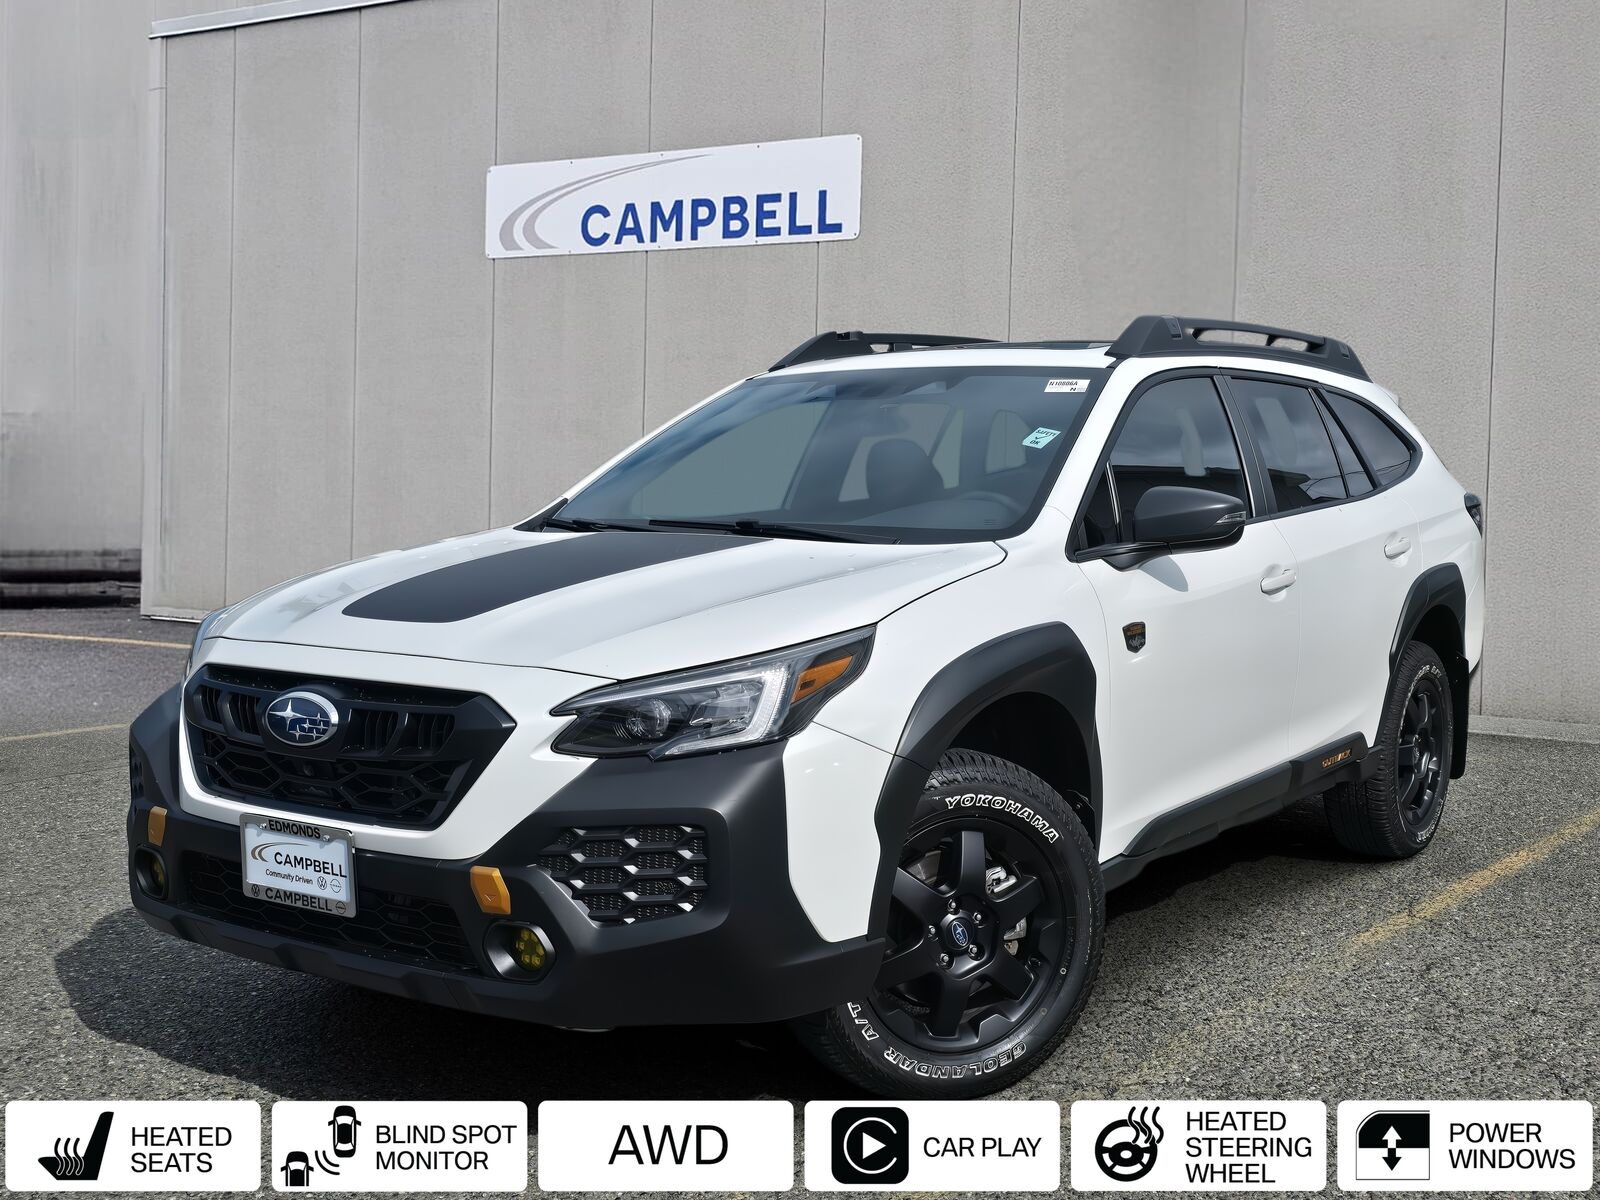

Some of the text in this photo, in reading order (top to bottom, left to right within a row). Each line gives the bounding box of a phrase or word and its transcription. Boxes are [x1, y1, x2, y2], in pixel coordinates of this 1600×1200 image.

[580, 189, 843, 247] CAMPBELL
[268, 819, 321, 839] EDMONDS
[945, 793, 1060, 844] YOKOHAMA
[265, 868, 314, 885] Community Driven
[274, 851, 348, 879] CAMPBELL
[265, 887, 333, 912] CAMPBELL
[847, 1001, 1027, 1079] GEOLANDAR A/T
